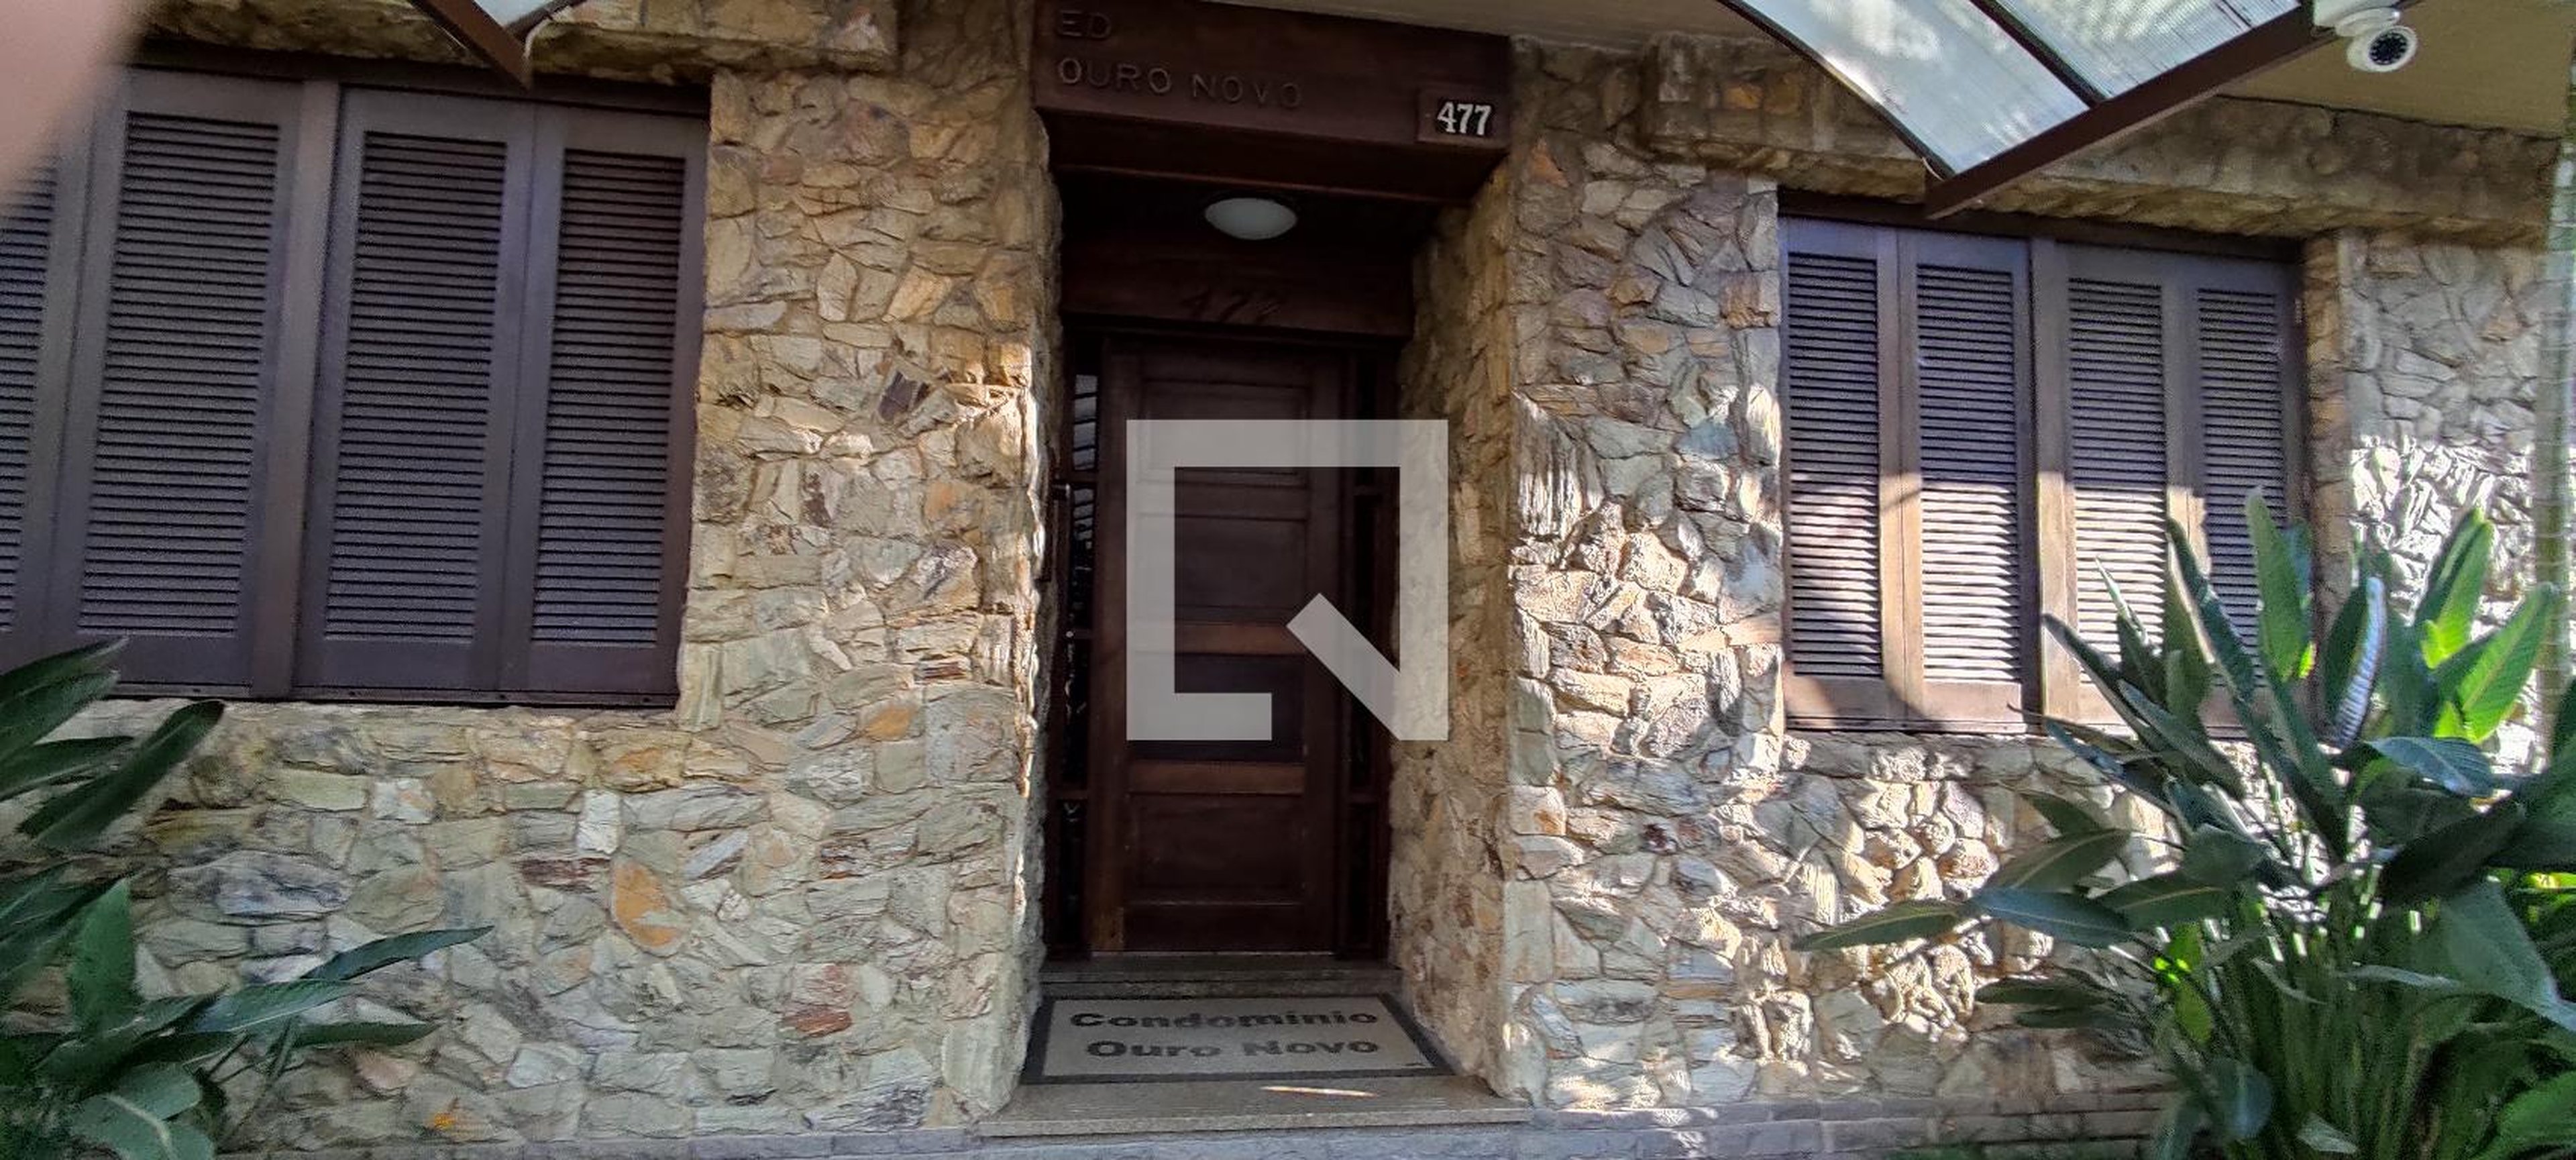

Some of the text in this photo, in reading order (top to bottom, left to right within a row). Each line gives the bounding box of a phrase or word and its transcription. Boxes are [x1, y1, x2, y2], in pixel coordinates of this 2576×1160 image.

[1058, 9, 1112, 39] ED
[1058, 58, 1302, 109] OURO NOVO
[1437, 101, 1491, 136] 477
[1087, 1040, 1377, 1057] Ouro Novo
